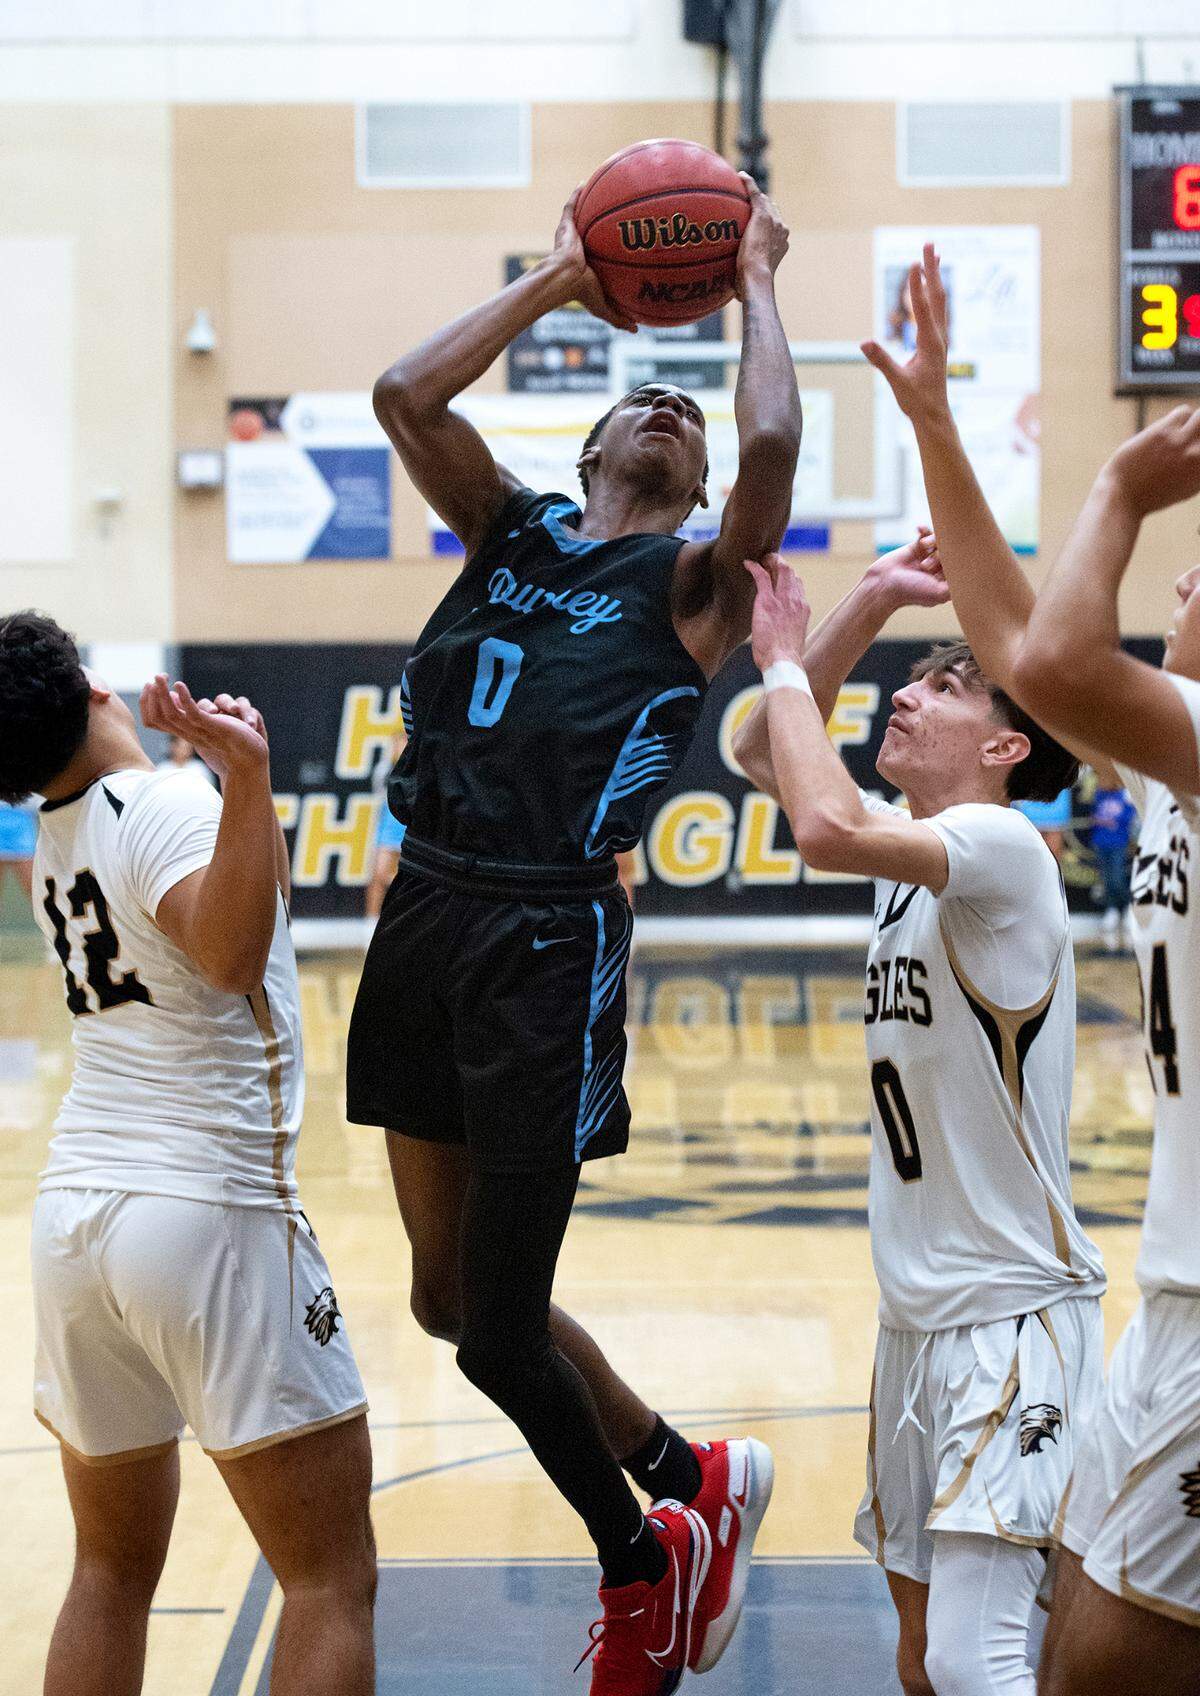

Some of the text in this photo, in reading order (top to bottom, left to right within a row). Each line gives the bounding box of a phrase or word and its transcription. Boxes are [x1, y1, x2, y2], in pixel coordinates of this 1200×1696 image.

[618, 212, 742, 251] Wilson
[1141, 284, 1178, 349] 3
[468, 637, 525, 728] 0
[44, 867, 155, 1017] 12
[1142, 942, 1181, 1097] 4
[871, 1056, 923, 1185] 0
